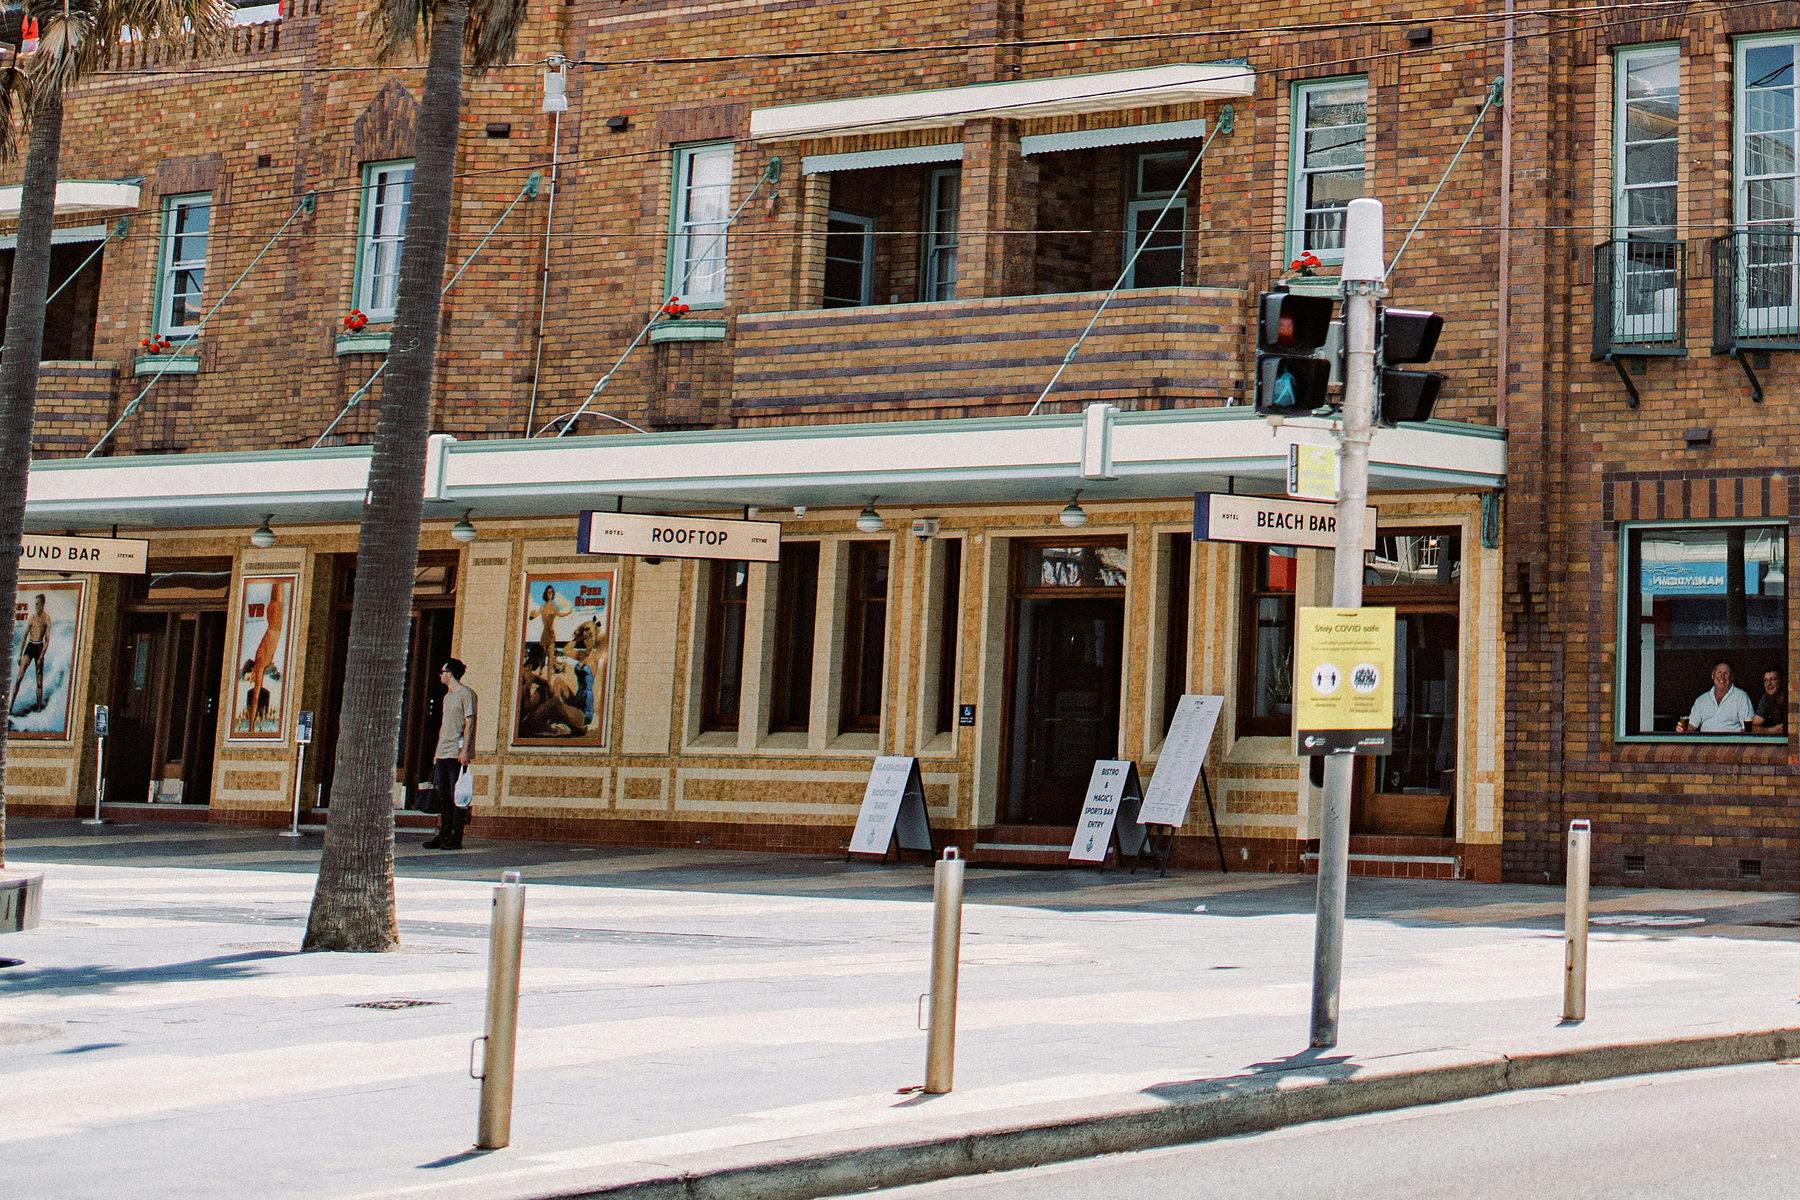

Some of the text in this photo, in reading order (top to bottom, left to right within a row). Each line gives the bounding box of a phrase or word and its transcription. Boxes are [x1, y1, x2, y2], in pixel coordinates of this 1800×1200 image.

[1257, 511, 1304, 530] BEACH
[1309, 515, 1336, 532] BAR
[652, 528, 728, 545] ROOFTOP
[68, 547, 101, 561] BAR
[1314, 625, 1333, 633] Stay
[1363, 624, 1380, 632] safe
[1101, 768, 1120, 776] BISTRO
[1084, 807, 1114, 816] SPORTS BAR
[1087, 820, 1105, 828] ENTRY
